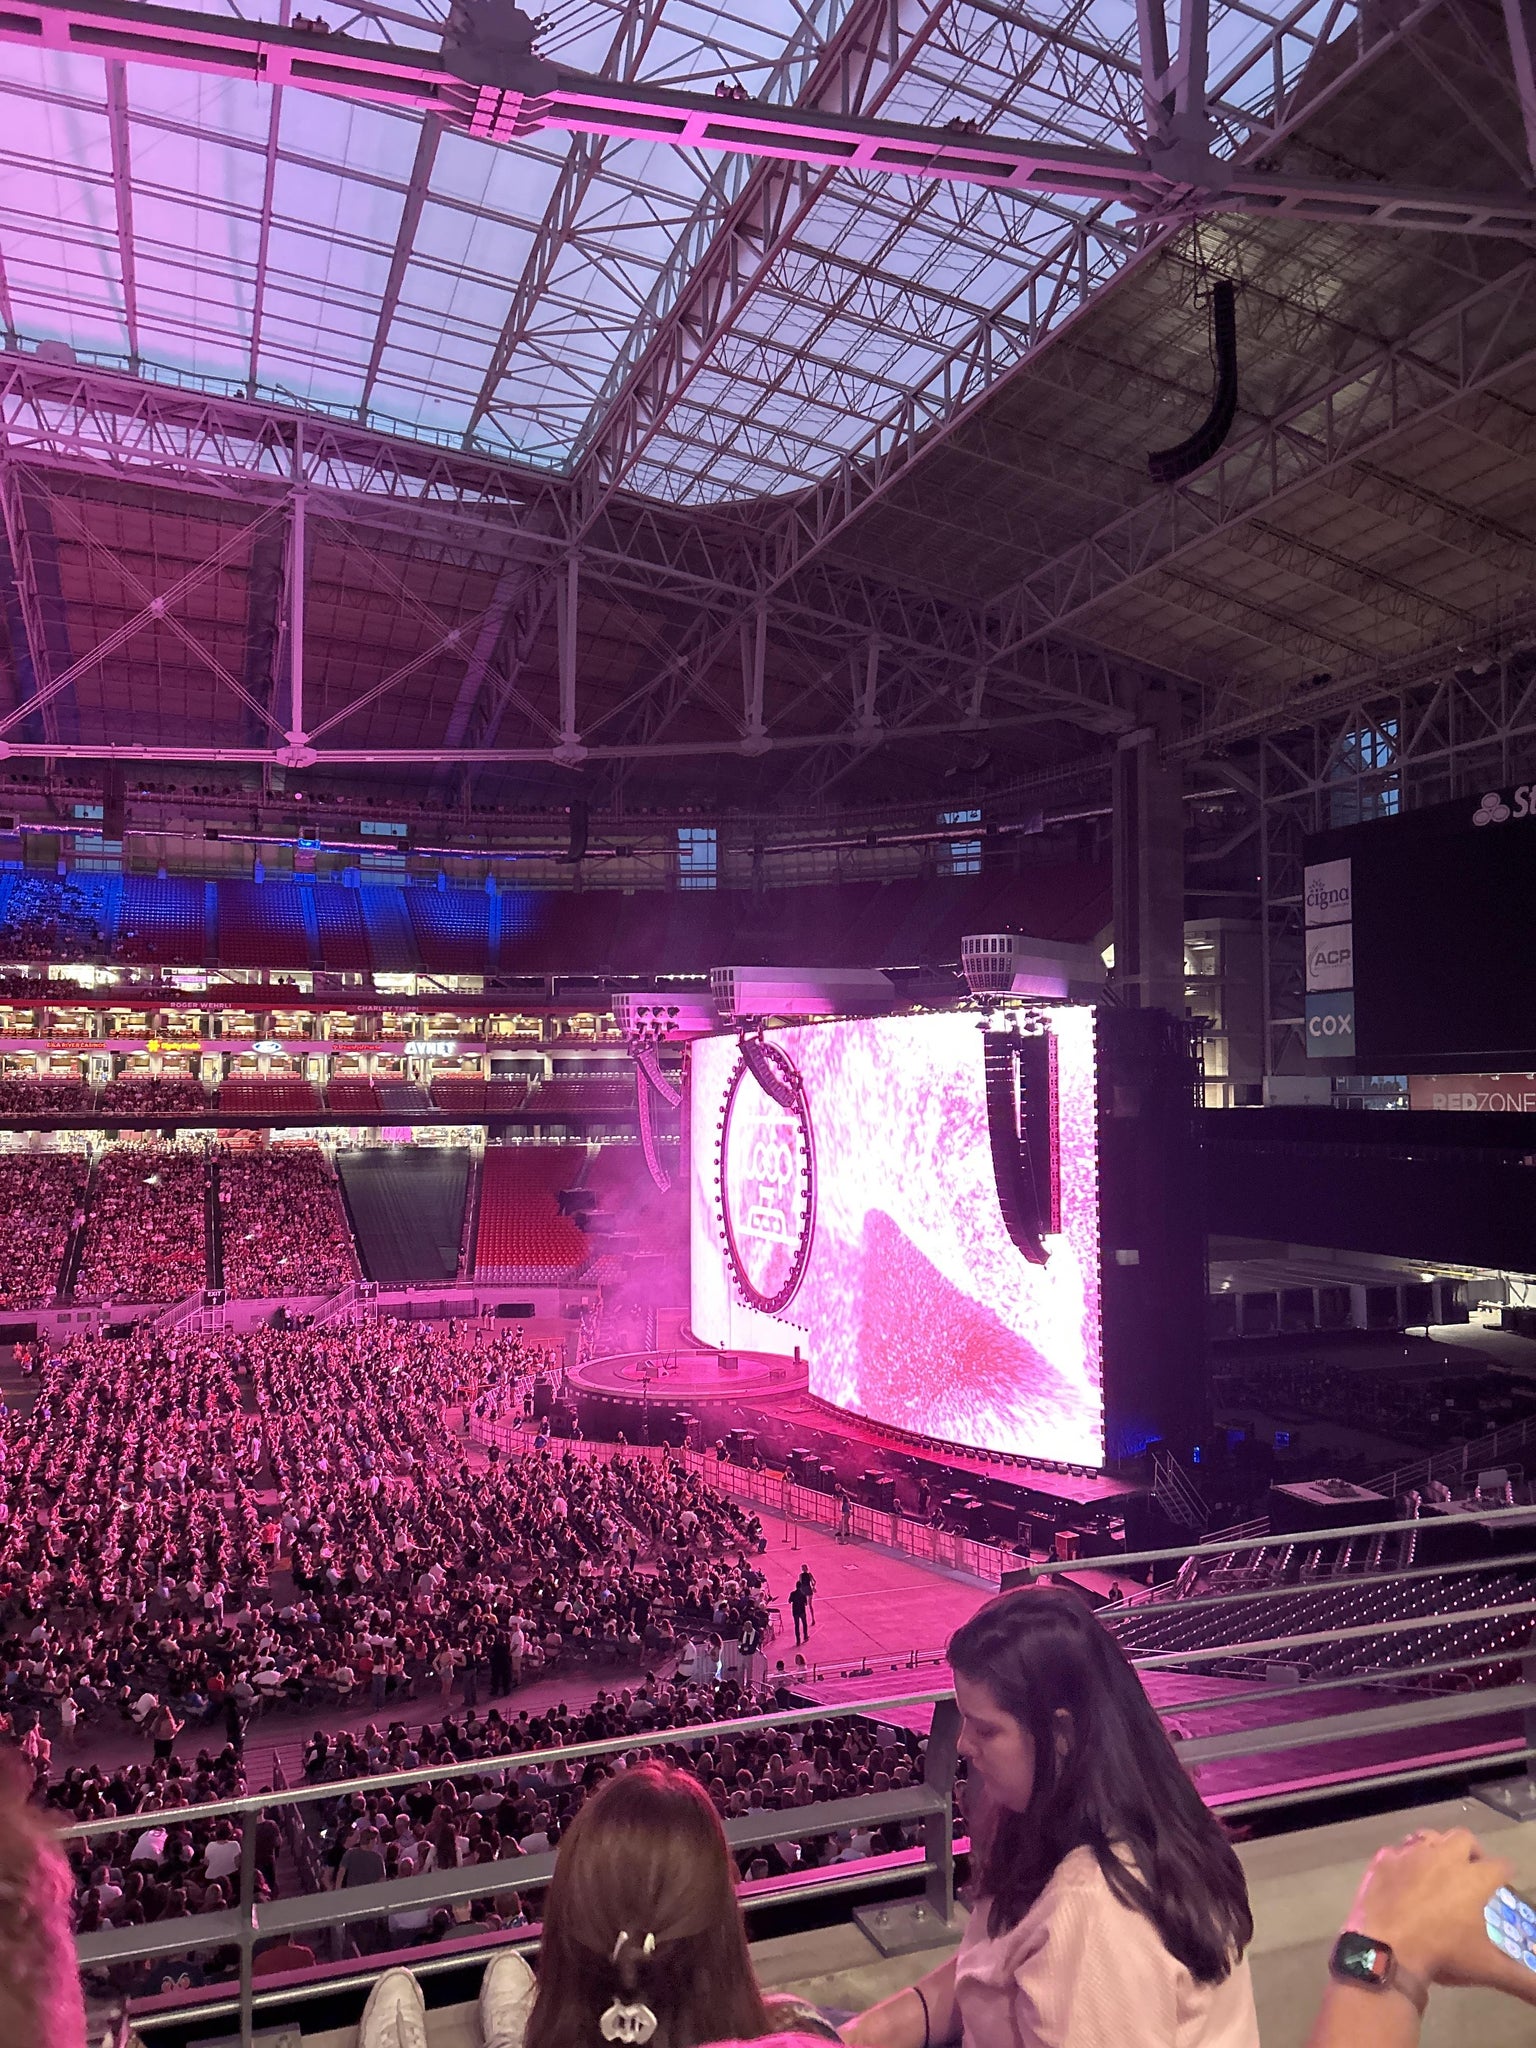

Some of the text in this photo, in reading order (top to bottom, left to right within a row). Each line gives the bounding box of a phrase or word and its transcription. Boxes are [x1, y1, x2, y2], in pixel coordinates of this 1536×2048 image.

[1306, 886, 1350, 911] cigna
[1315, 948, 1352, 967] ACP
[1309, 1013, 1352, 1037] COX
